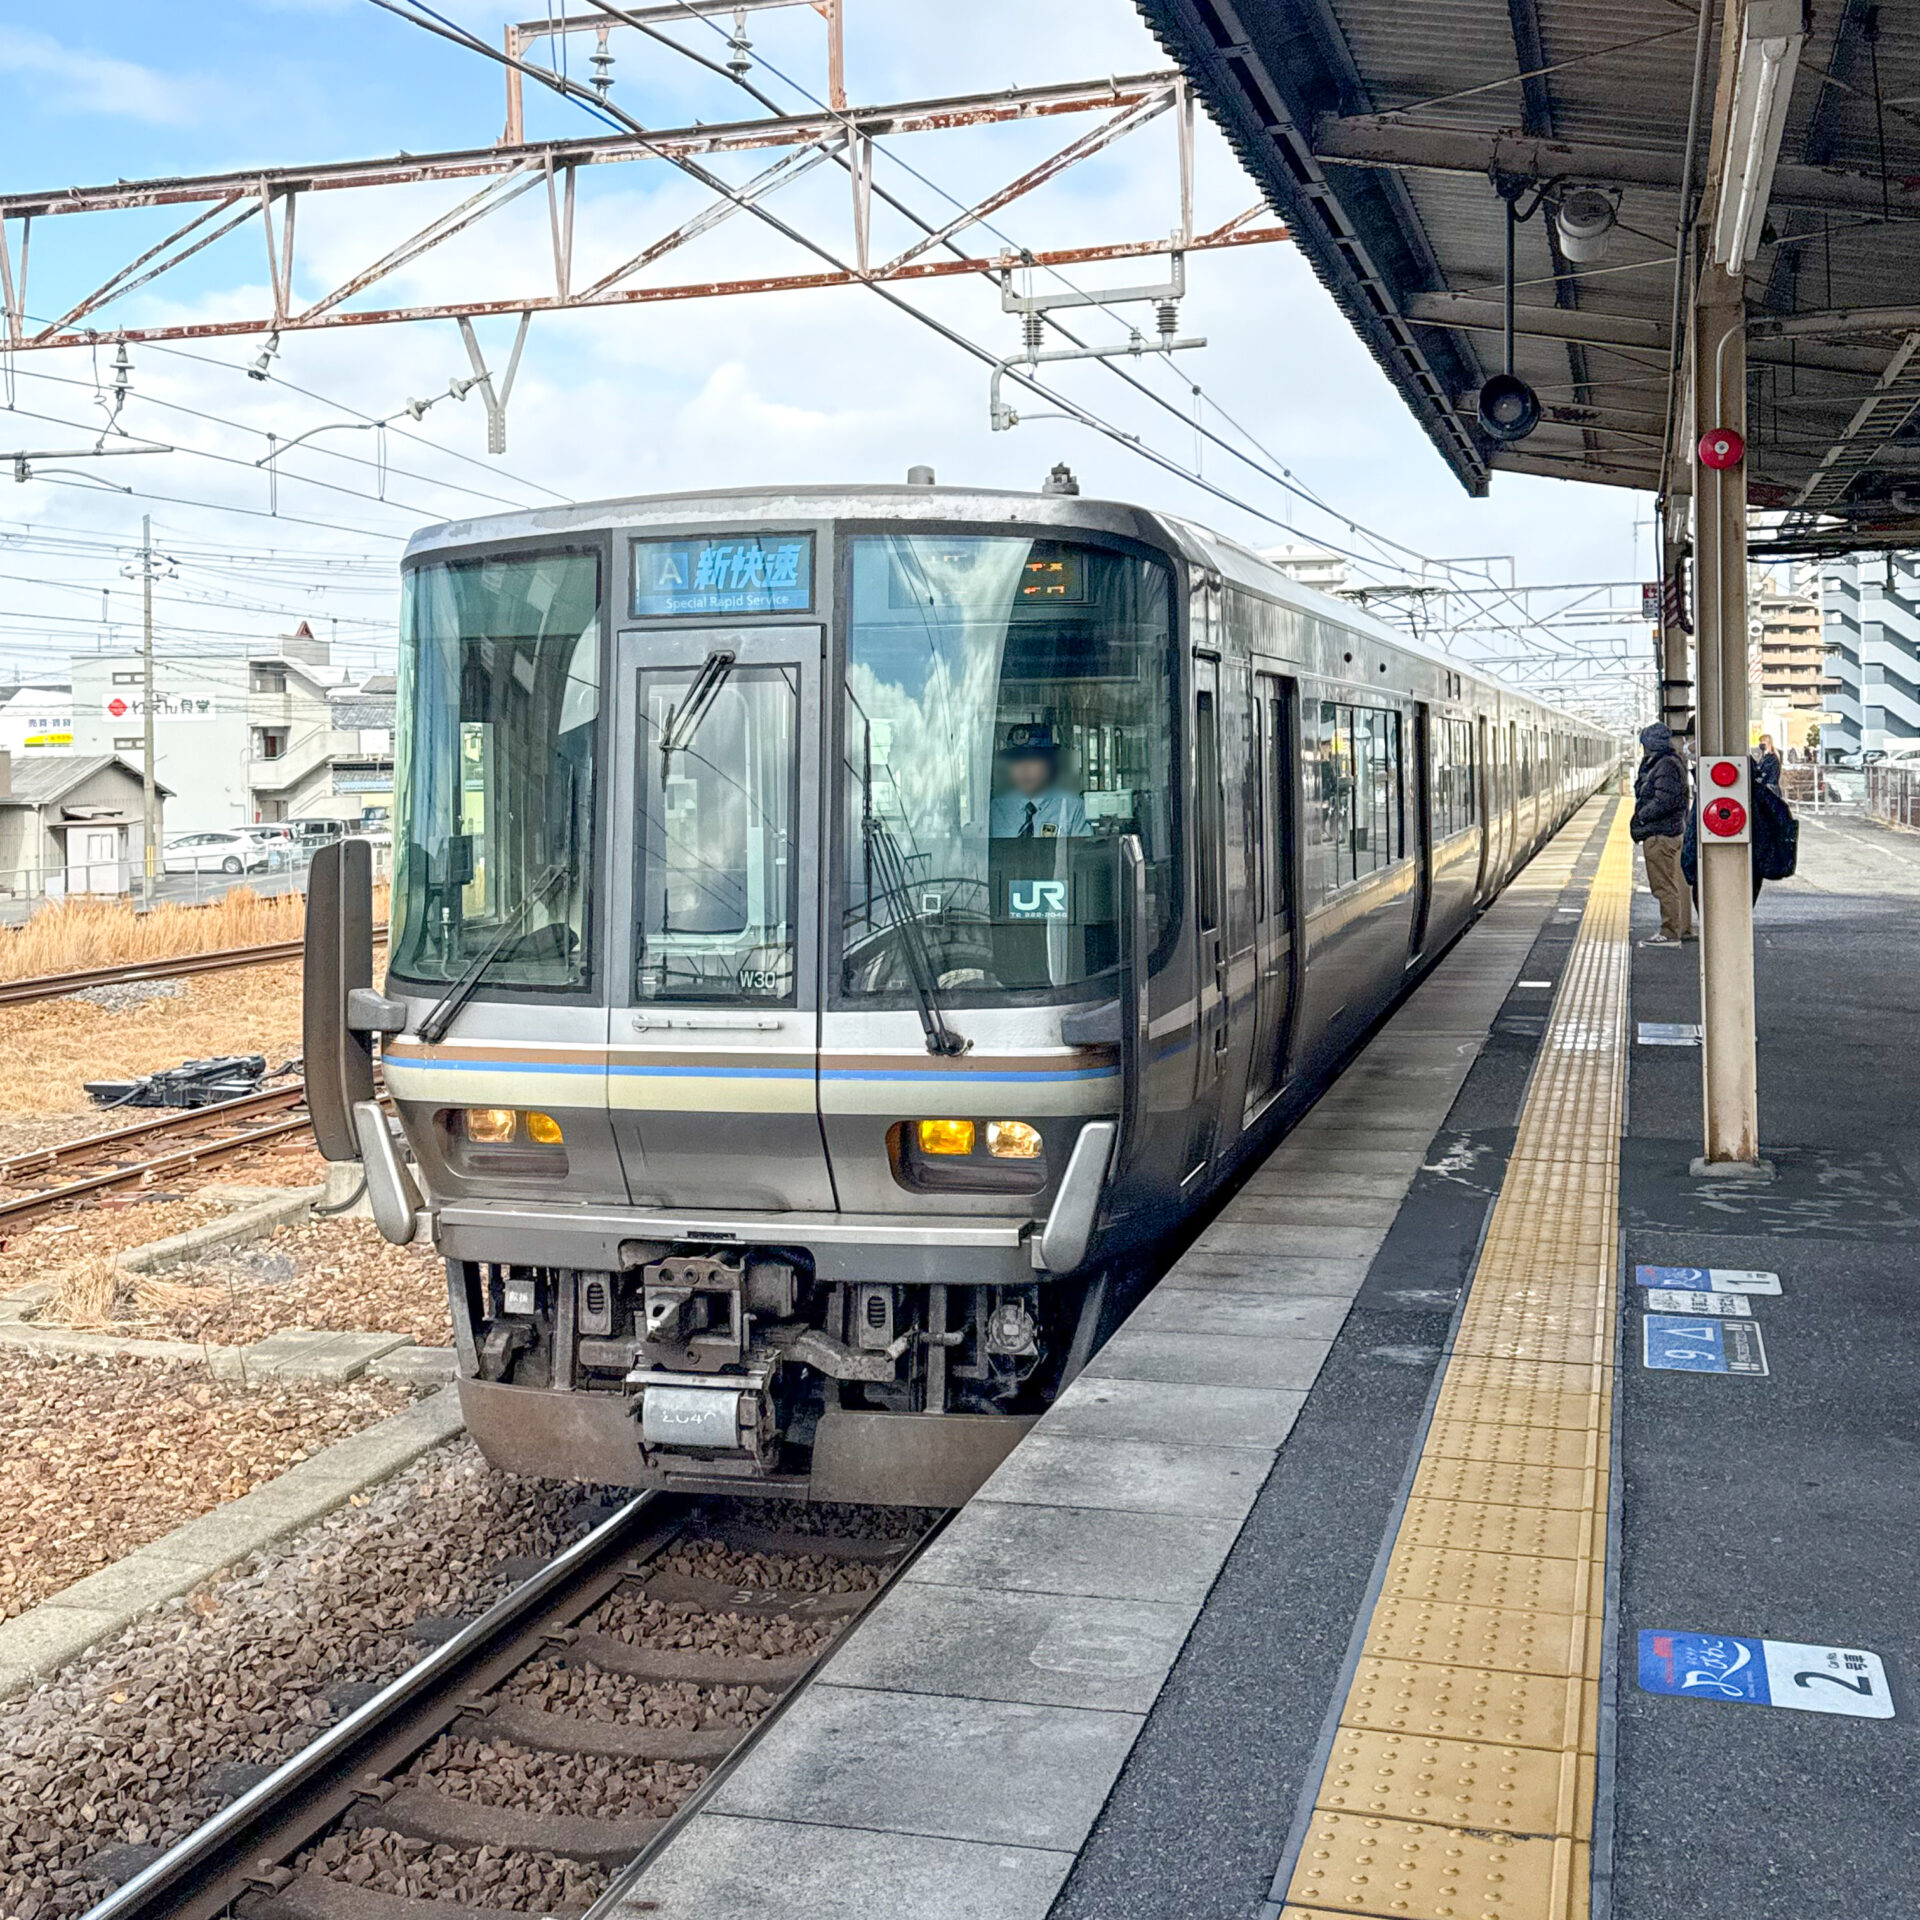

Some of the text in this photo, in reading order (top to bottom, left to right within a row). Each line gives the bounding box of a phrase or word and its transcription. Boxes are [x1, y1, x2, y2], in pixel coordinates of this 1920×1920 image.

[658, 557, 683, 585] A
[693, 544, 803, 591] 新快速
[666, 593, 789, 610] Special Rapid Service
[1012, 881, 1065, 911] JR
[740, 970, 776, 989] W30
[1665, 1349, 1716, 1361] 9
[1793, 1653, 1874, 1697] 2 号車
